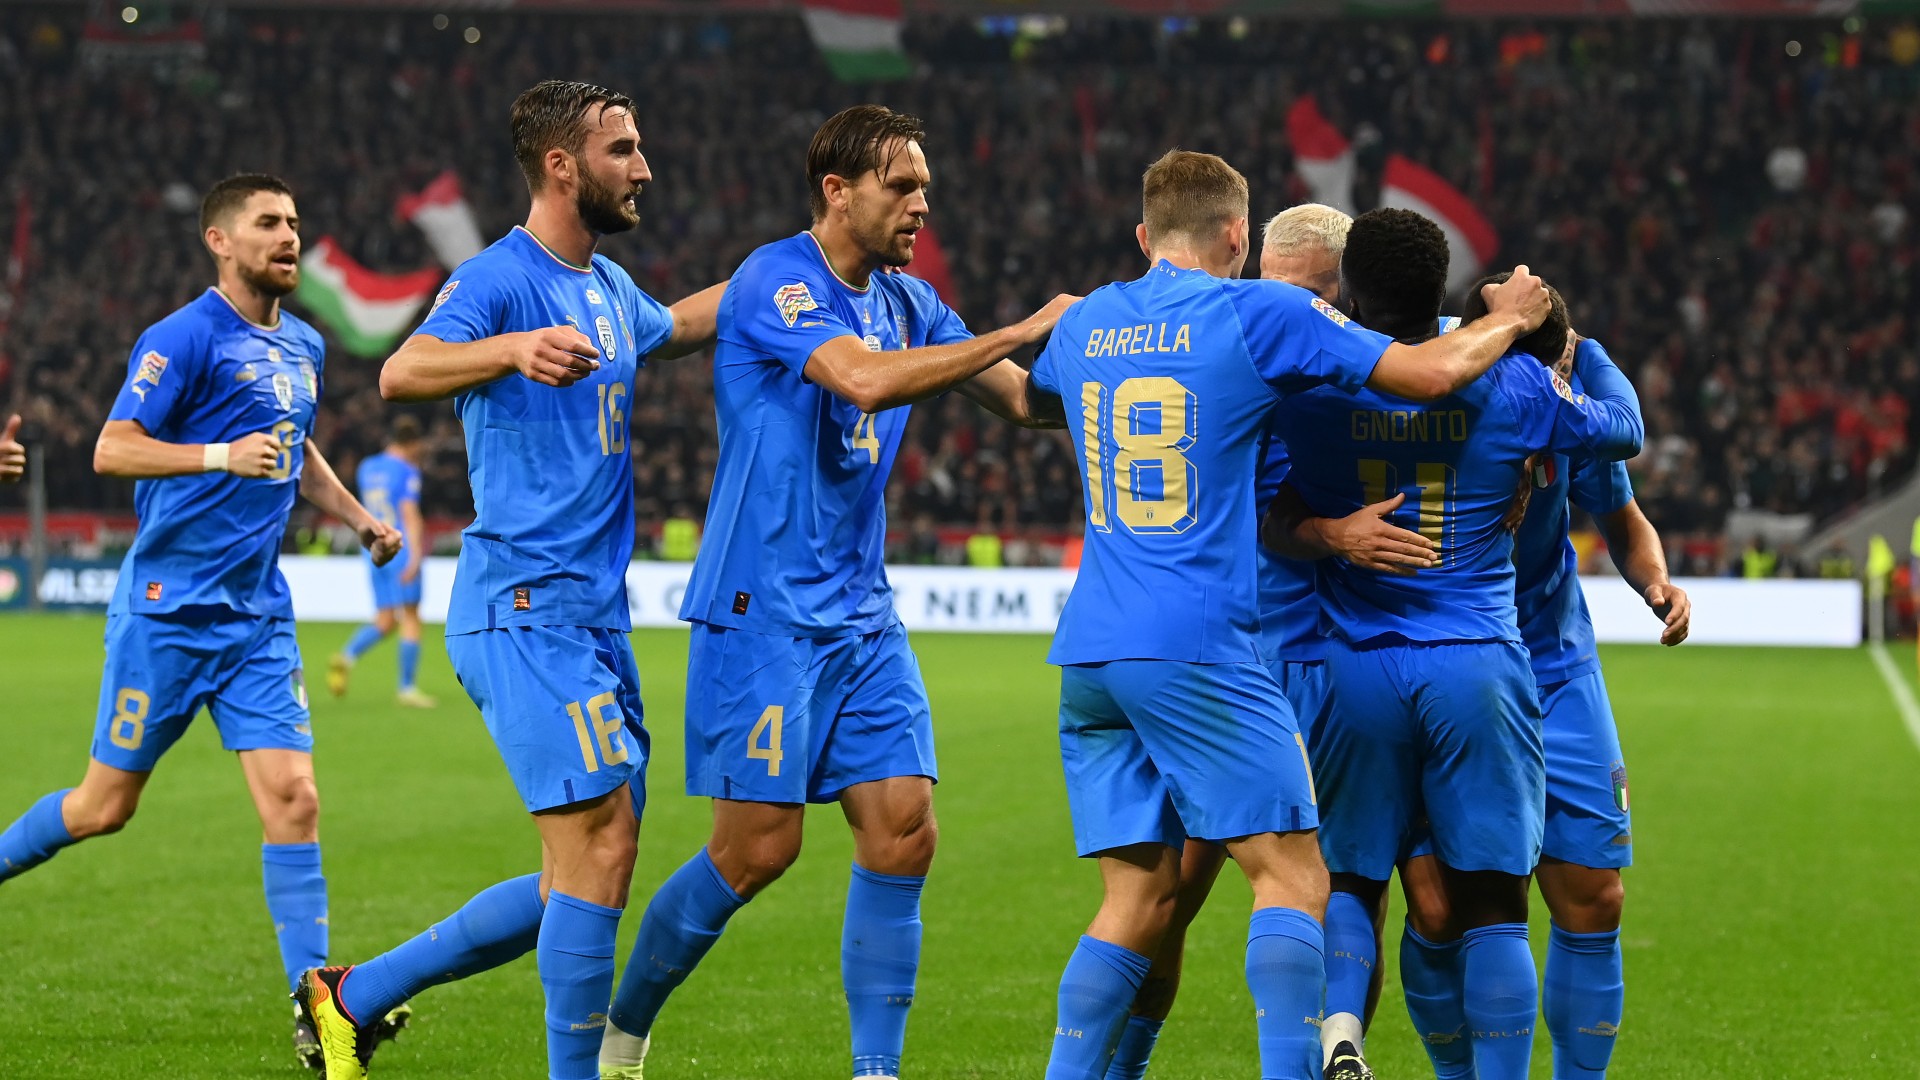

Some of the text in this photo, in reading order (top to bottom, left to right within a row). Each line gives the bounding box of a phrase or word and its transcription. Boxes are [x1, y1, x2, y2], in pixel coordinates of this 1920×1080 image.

[1085, 323, 1191, 357] BARELLA
[597, 382, 626, 456] 16
[852, 411, 880, 464] 4
[1351, 409, 1467, 442] GNONTO
[1081, 376, 1198, 535] 18
[926, 587, 1028, 620] NEM
[110, 687, 150, 751] 8
[566, 690, 628, 773] 16
[747, 704, 784, 777] 4
